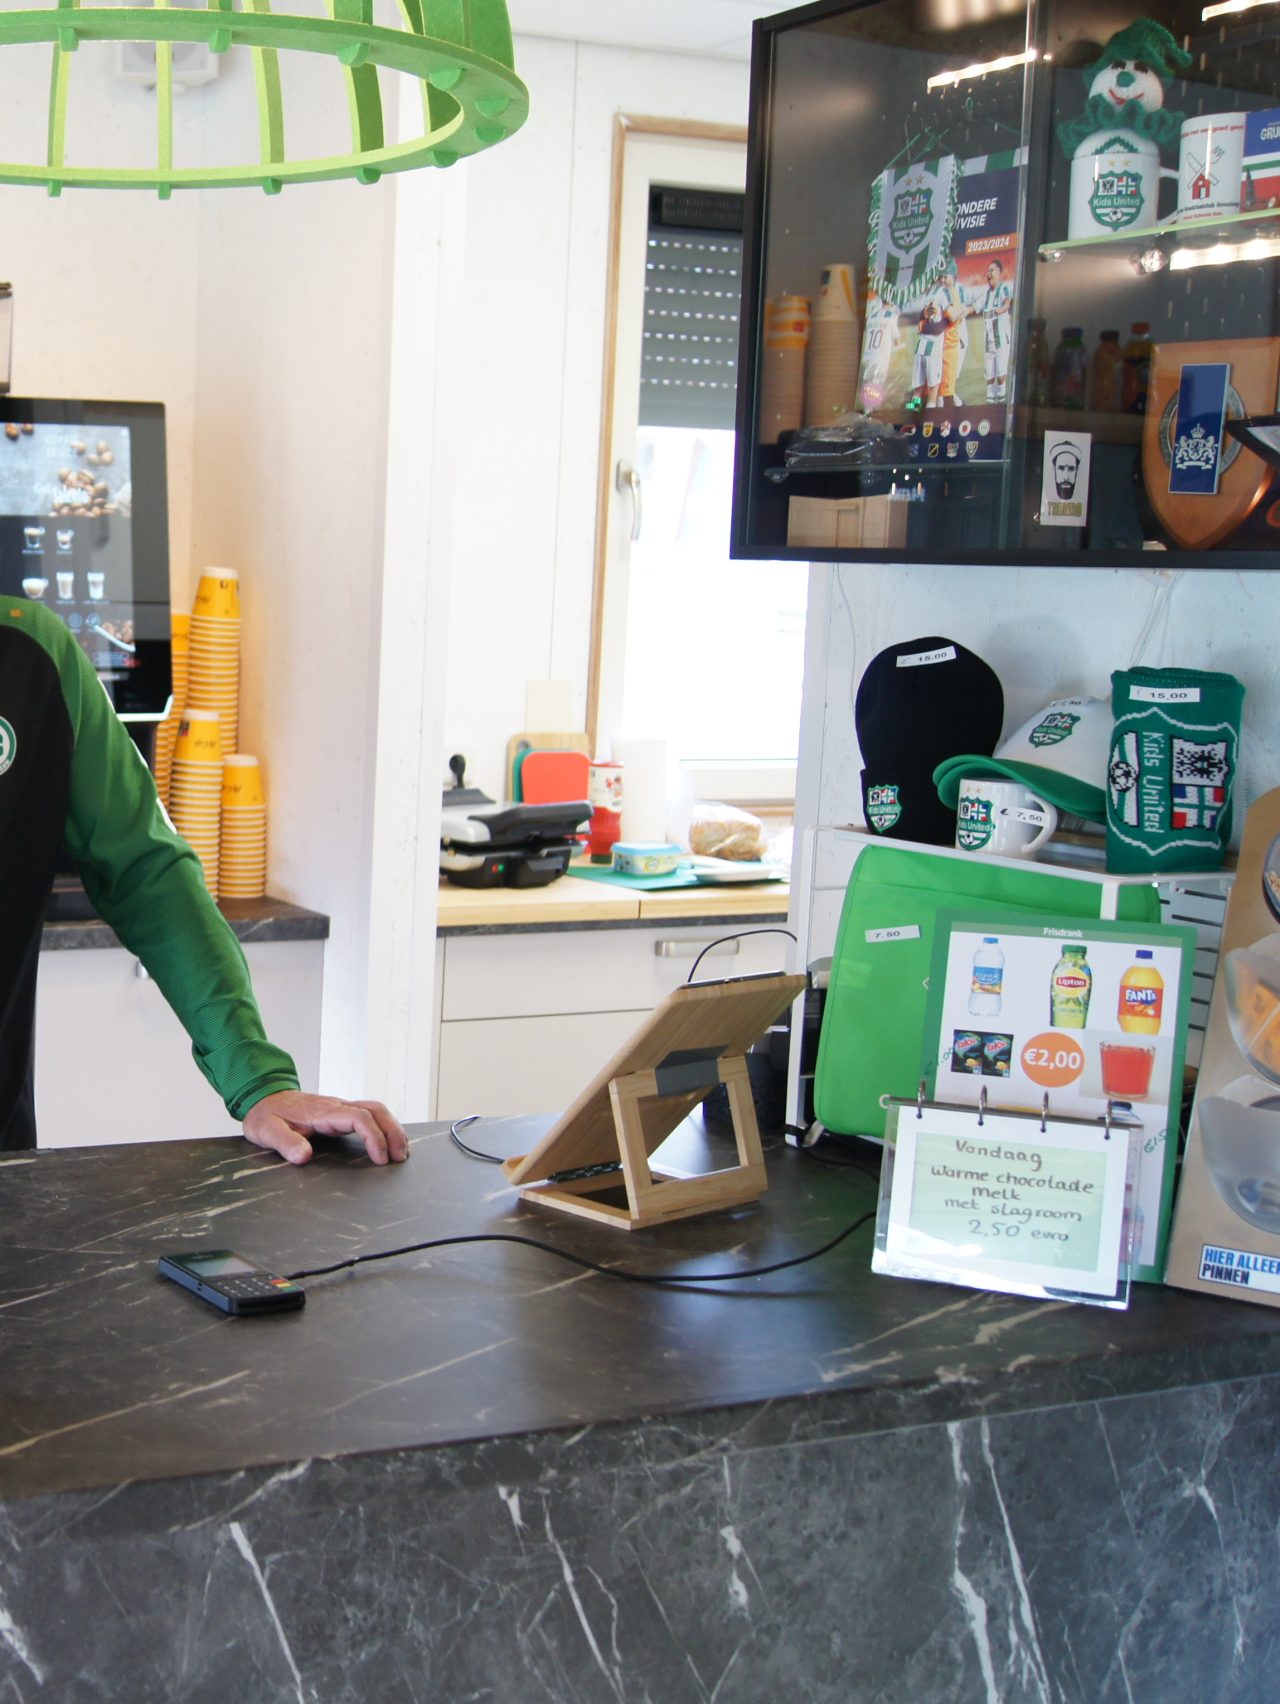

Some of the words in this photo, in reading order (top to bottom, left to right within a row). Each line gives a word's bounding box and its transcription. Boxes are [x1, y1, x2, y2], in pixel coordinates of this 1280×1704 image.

[956, 197, 998, 215] ONDERE
[1093, 197, 1112, 207] Kids
[1113, 197, 1140, 207] United
[892, 219, 907, 229] Kids
[907, 217, 929, 228] United
[953, 214, 987, 229] IVISIE
[967, 237, 1009, 253] 2023/2024
[1142, 732, 1165, 767] Kids
[1142, 775, 1165, 833] United
[967, 823, 990, 832] United
[1042, 927, 1083, 939] Frisdrank
[1058, 977, 1085, 986] Lipton
[1125, 989, 1157, 1001] FANTA
[1024, 1048, 1081, 1070] €2,00
[955, 1138, 1043, 1172] Vandaag
[996, 1171, 1095, 1194] chocolade
[944, 1197, 980, 1211] met
[991, 1202, 1082, 1224] slagroom
[1030, 1228, 1070, 1242] euro
[1204, 1247, 1235, 1266] HIER
[1201, 1263, 1250, 1285] PINNEN
